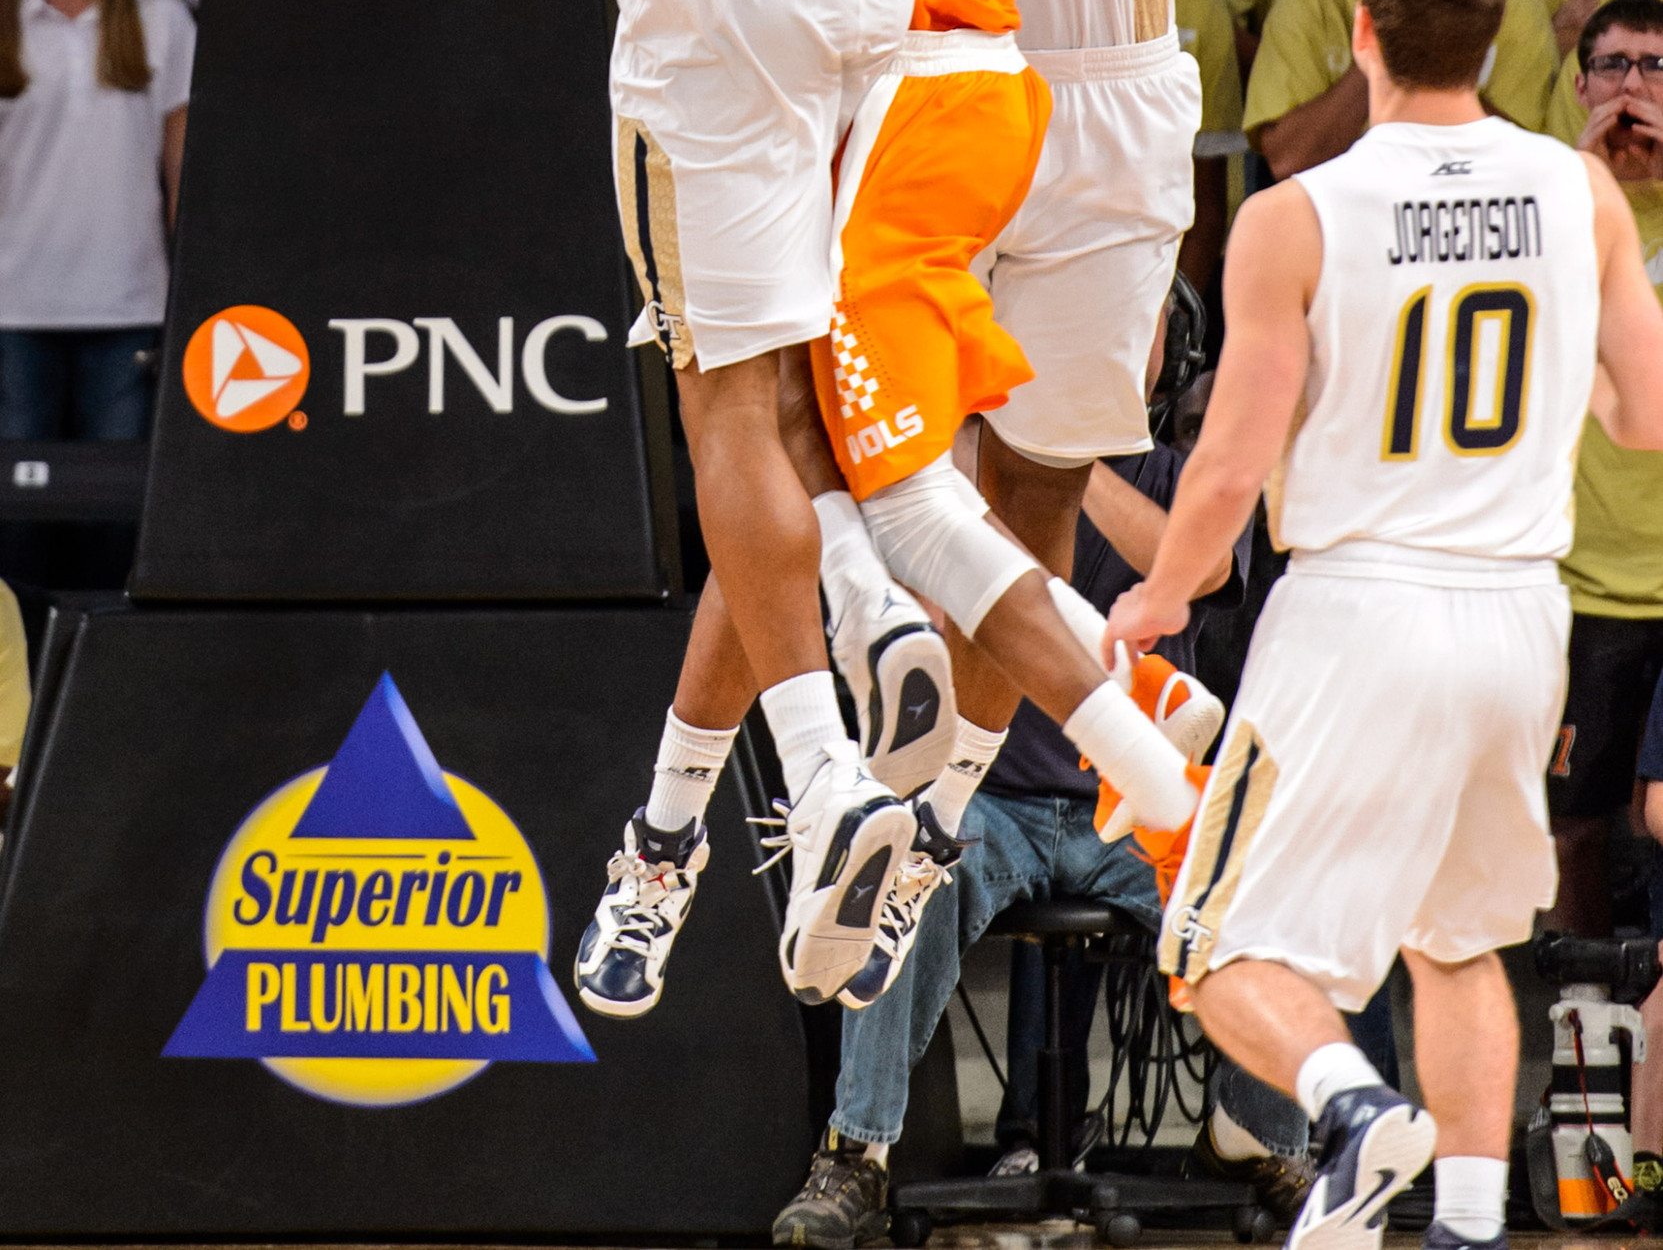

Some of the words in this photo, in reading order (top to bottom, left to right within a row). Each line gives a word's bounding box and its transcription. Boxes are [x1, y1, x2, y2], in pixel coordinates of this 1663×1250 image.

[1430, 160, 1474, 176] ACC
[1388, 196, 1544, 266] JORGENSON
[646, 299, 684, 340] GT
[327, 314, 609, 416] PNC
[1380, 281, 1538, 462] 10
[845, 403, 925, 466] VOLS
[233, 850, 522, 944] Superior
[1171, 904, 1213, 953] GT
[245, 962, 511, 1035] PLUMBING
